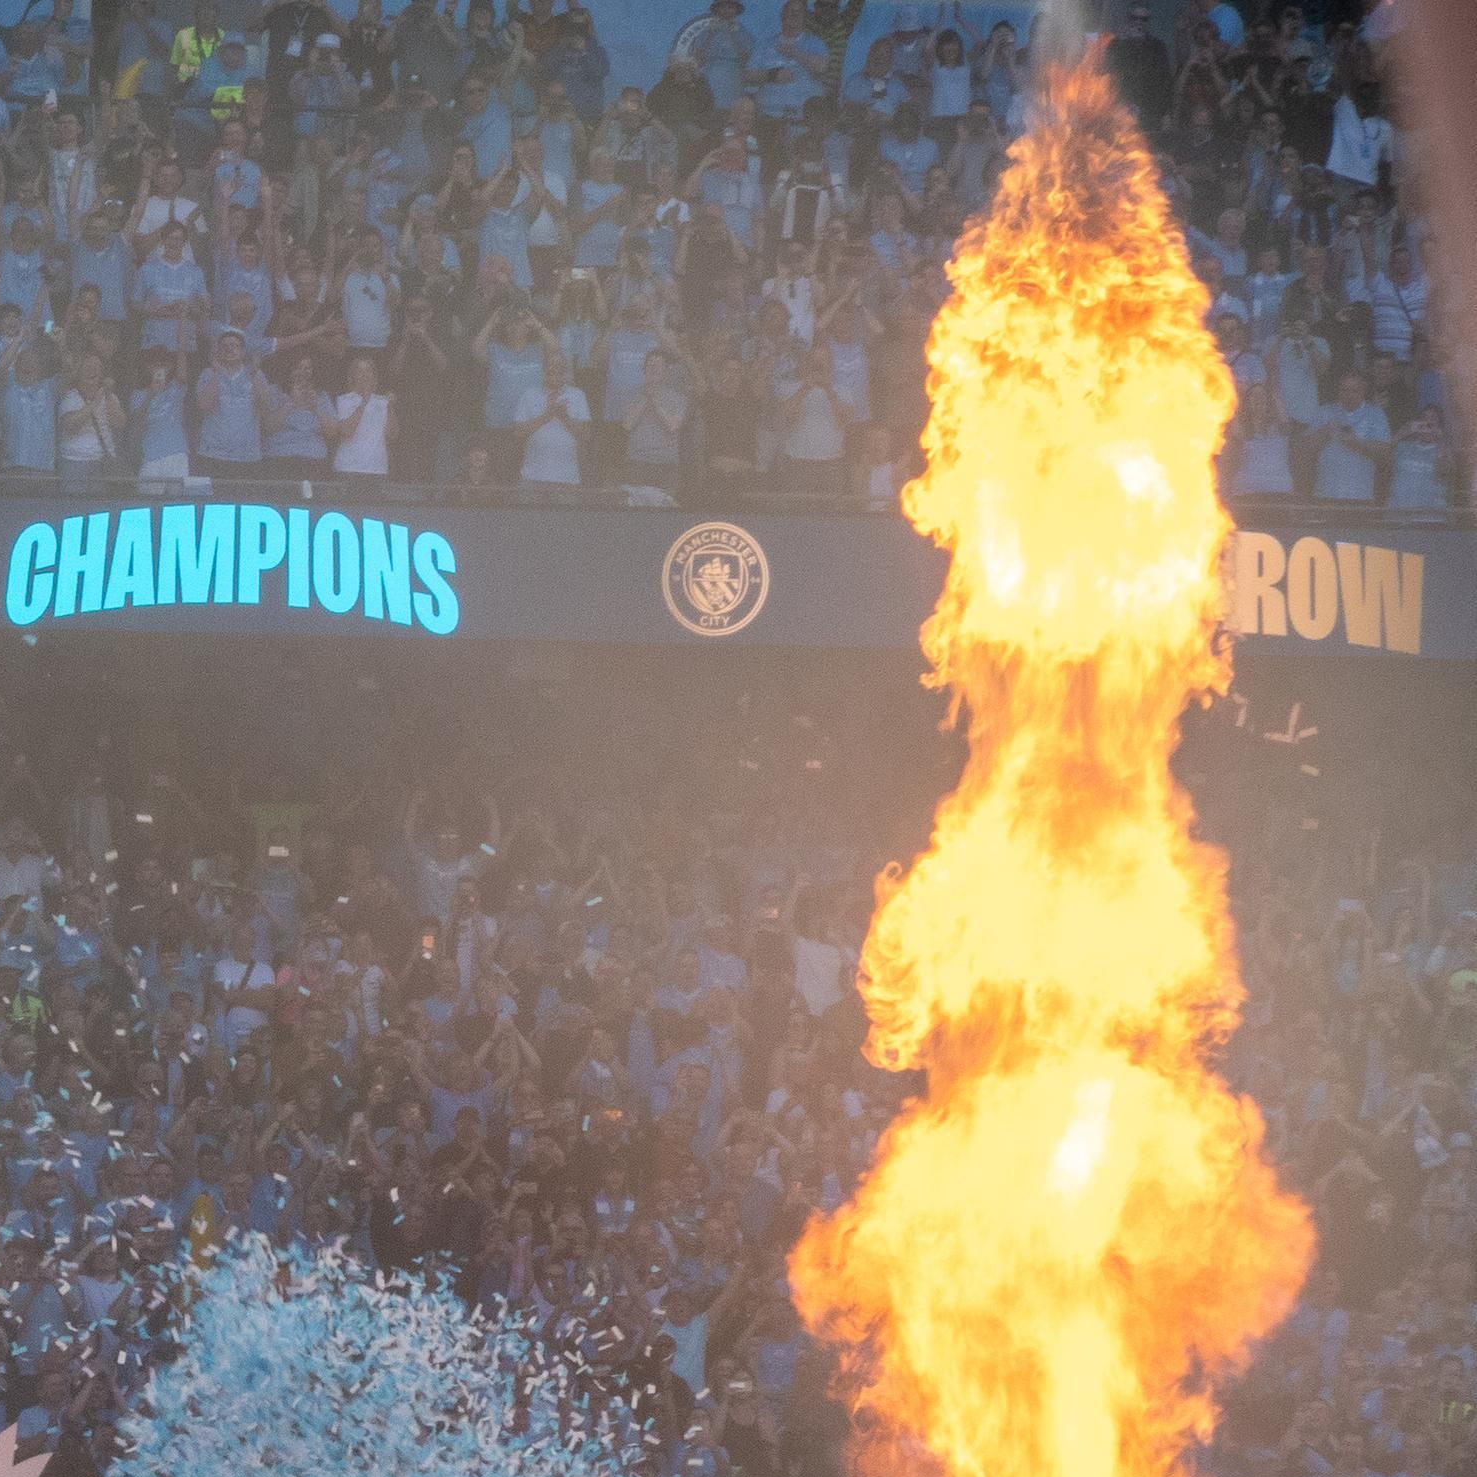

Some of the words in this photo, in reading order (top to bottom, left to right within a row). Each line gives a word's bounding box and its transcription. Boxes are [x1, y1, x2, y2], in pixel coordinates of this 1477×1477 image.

[675, 530, 759, 566] MANCHESTER
[5, 504, 459, 635] CHAMPIONS
[699, 615, 731, 627] CITY
